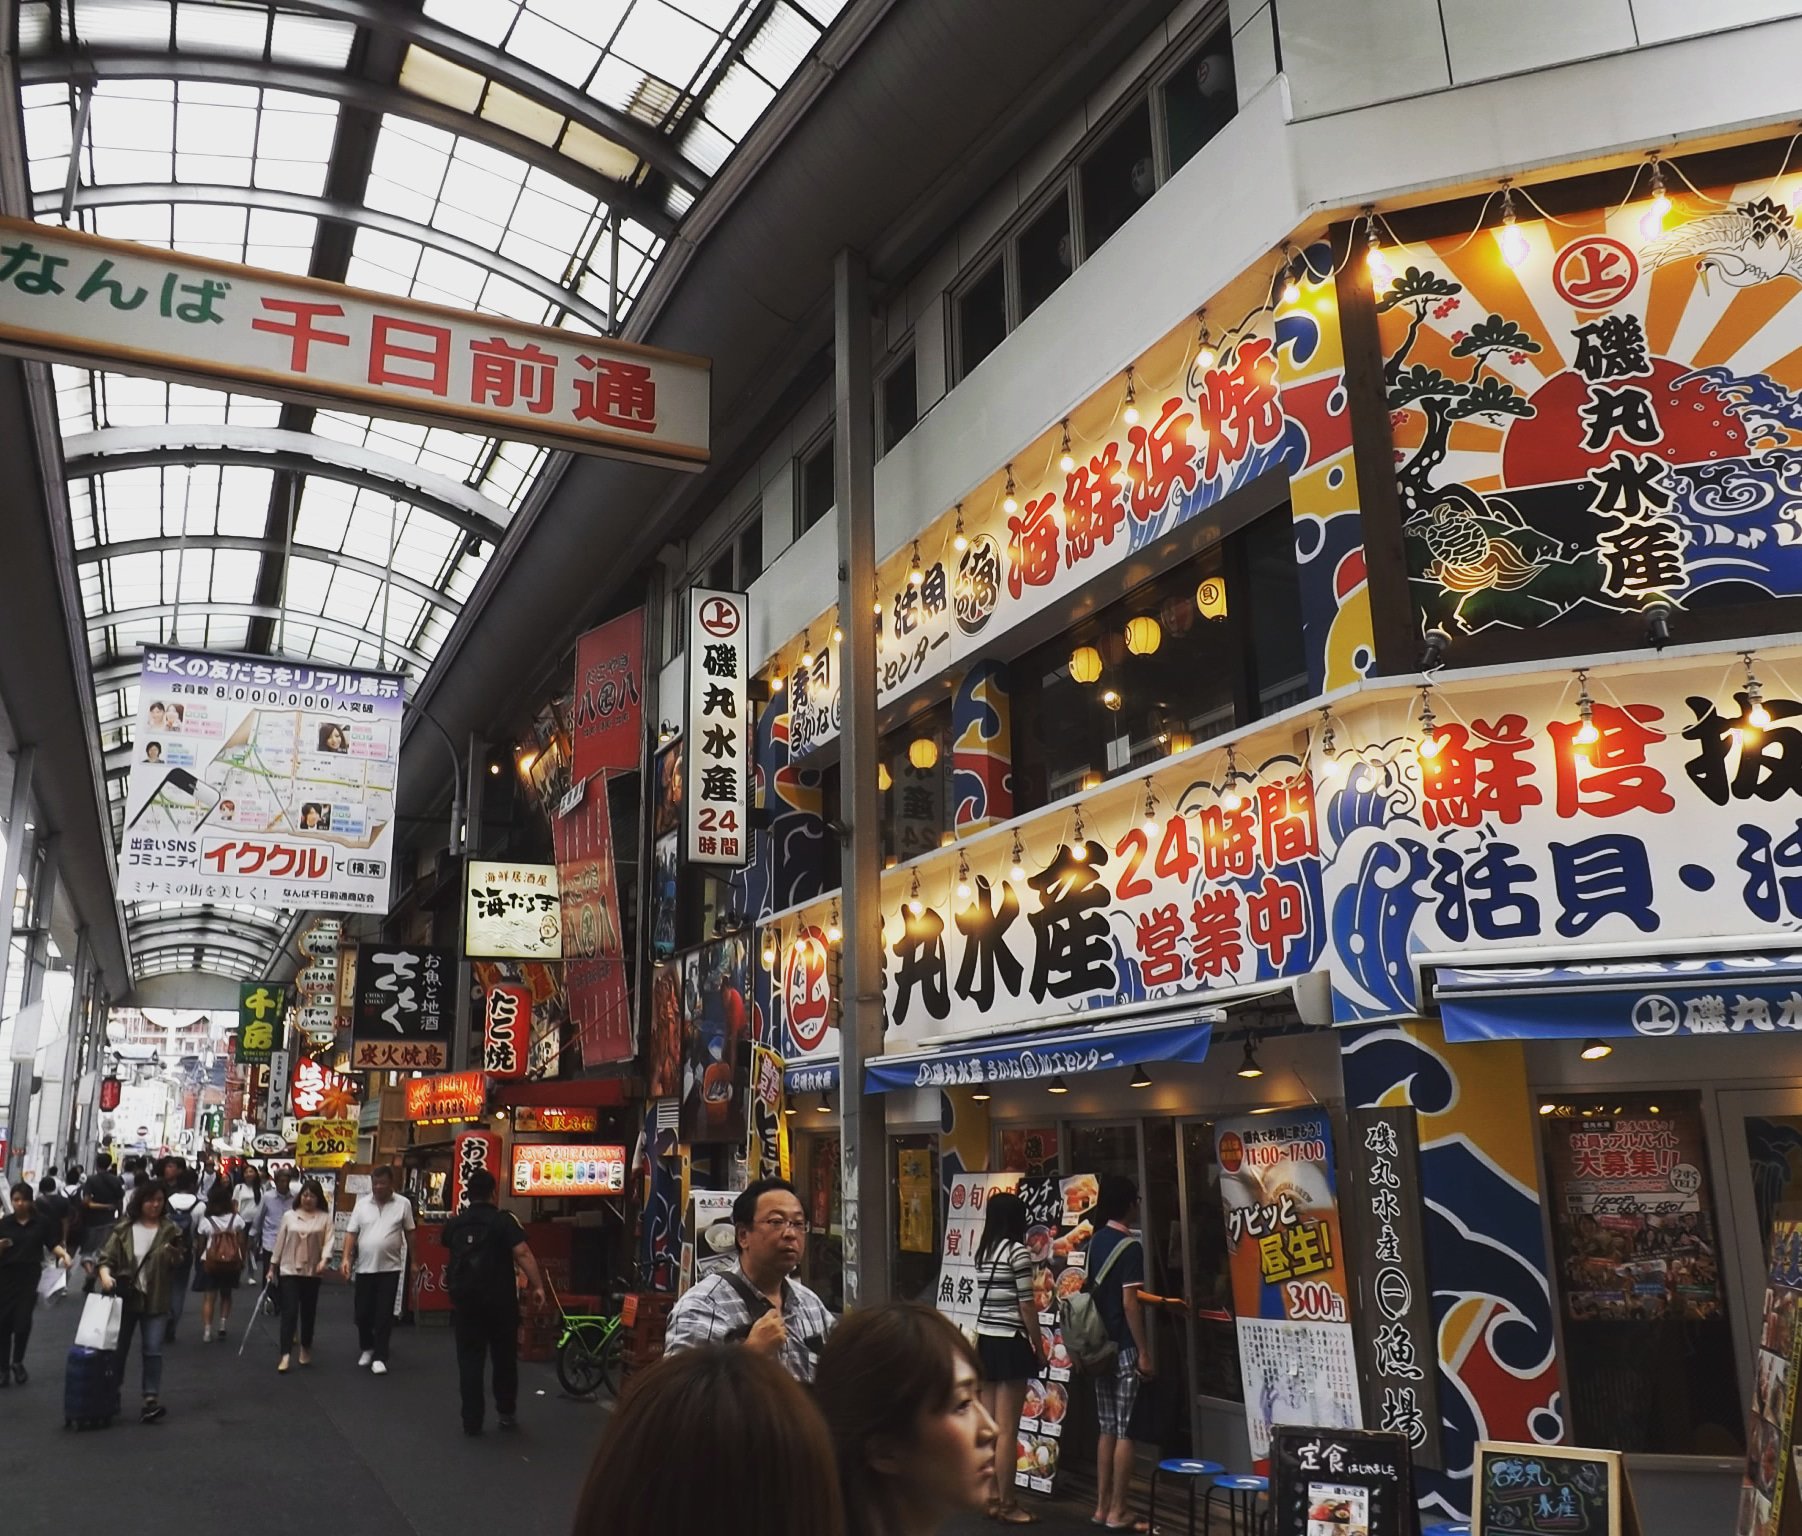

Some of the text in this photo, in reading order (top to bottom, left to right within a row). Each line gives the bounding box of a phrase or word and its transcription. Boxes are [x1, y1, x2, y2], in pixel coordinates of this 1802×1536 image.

[1007, 337, 1284, 600] 海鮮浜焼
[1572, 314, 1685, 594] 磯丸水産
[146, 653, 400, 698] 近くの友だちをリアル表示
[702, 643, 738, 803] 磯丸水産
[130, 838, 197, 853] 出会いSNS
[204, 841, 328, 879] イククル
[880, 841, 1118, 1032] 丸水産
[1136, 877, 1305, 988] 営業中
[421, 953, 442, 1031] お魚と地酒
[357, 1044, 443, 1067] 炭火焼鳥
[1365, 1122, 1400, 1262] 磯丸水産
